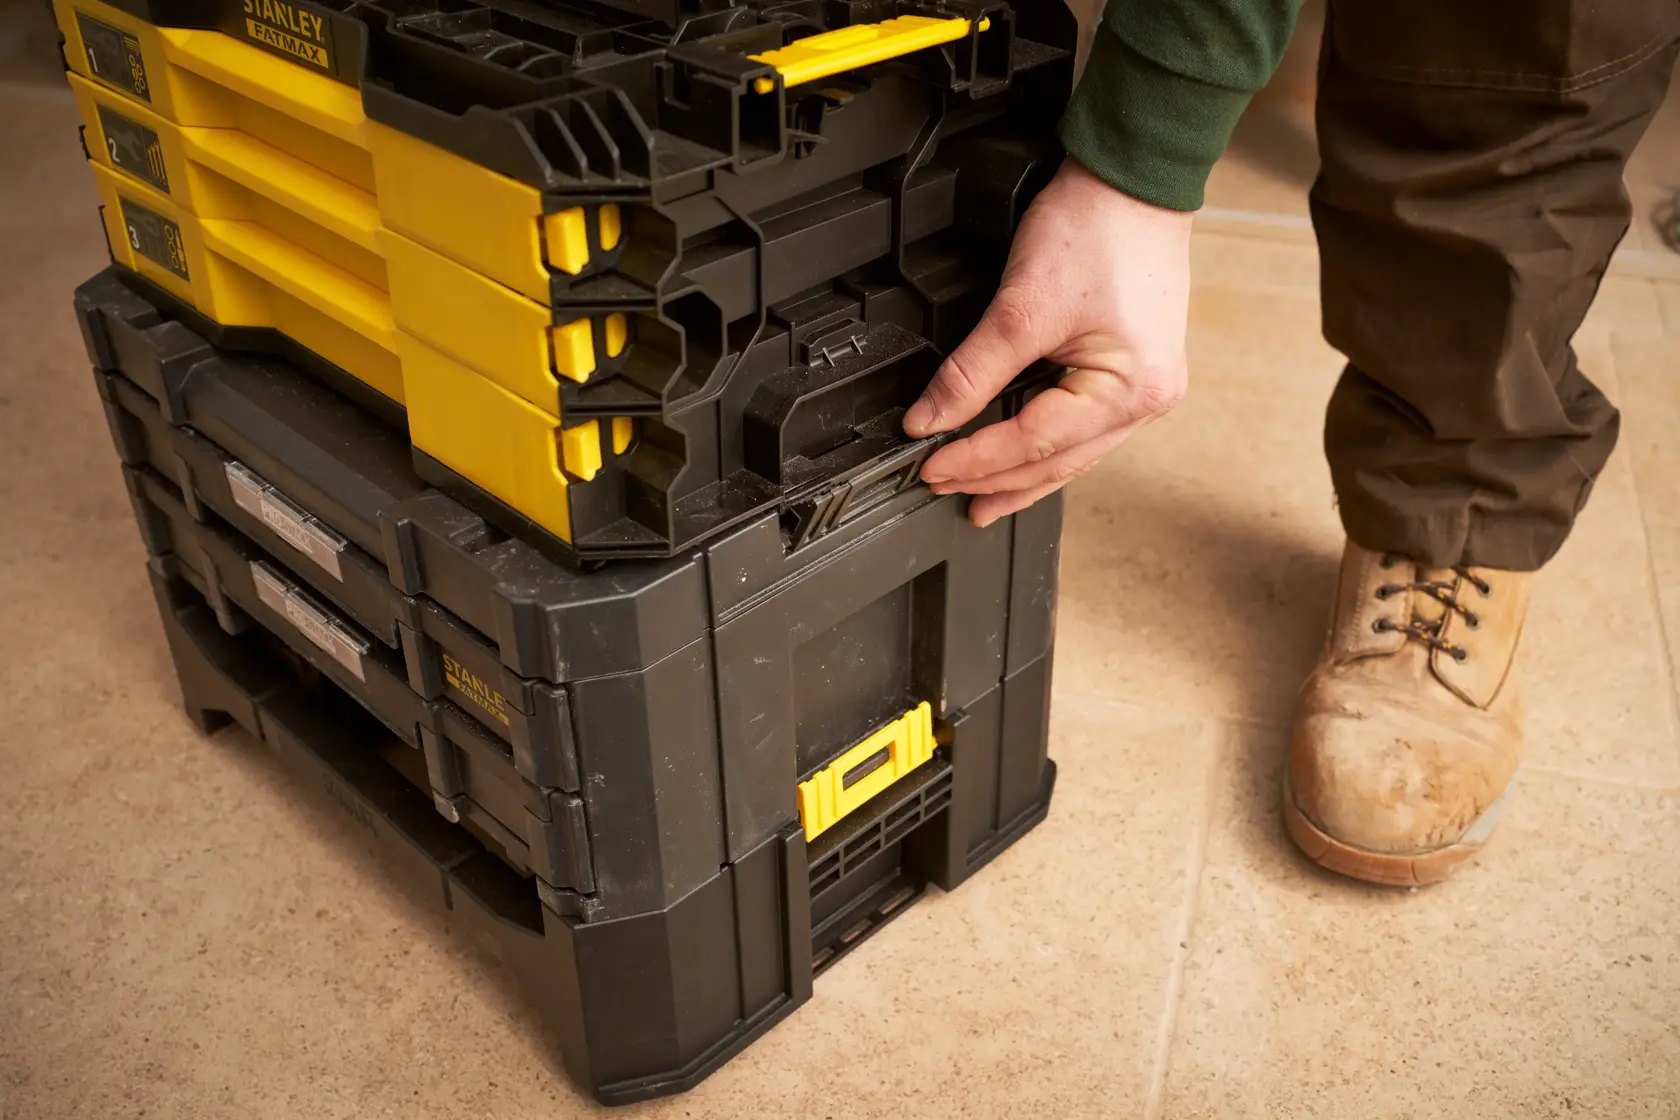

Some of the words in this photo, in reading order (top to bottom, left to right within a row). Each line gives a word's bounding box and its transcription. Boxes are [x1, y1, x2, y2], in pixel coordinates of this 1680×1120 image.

[244, 0, 322, 42] STANLEY
[254, 22, 321, 63] FATMAX
[87, 47, 99, 73] 1
[107, 137, 120, 163] 2
[128, 225, 140, 250] 3
[442, 653, 505, 712] STANLE
